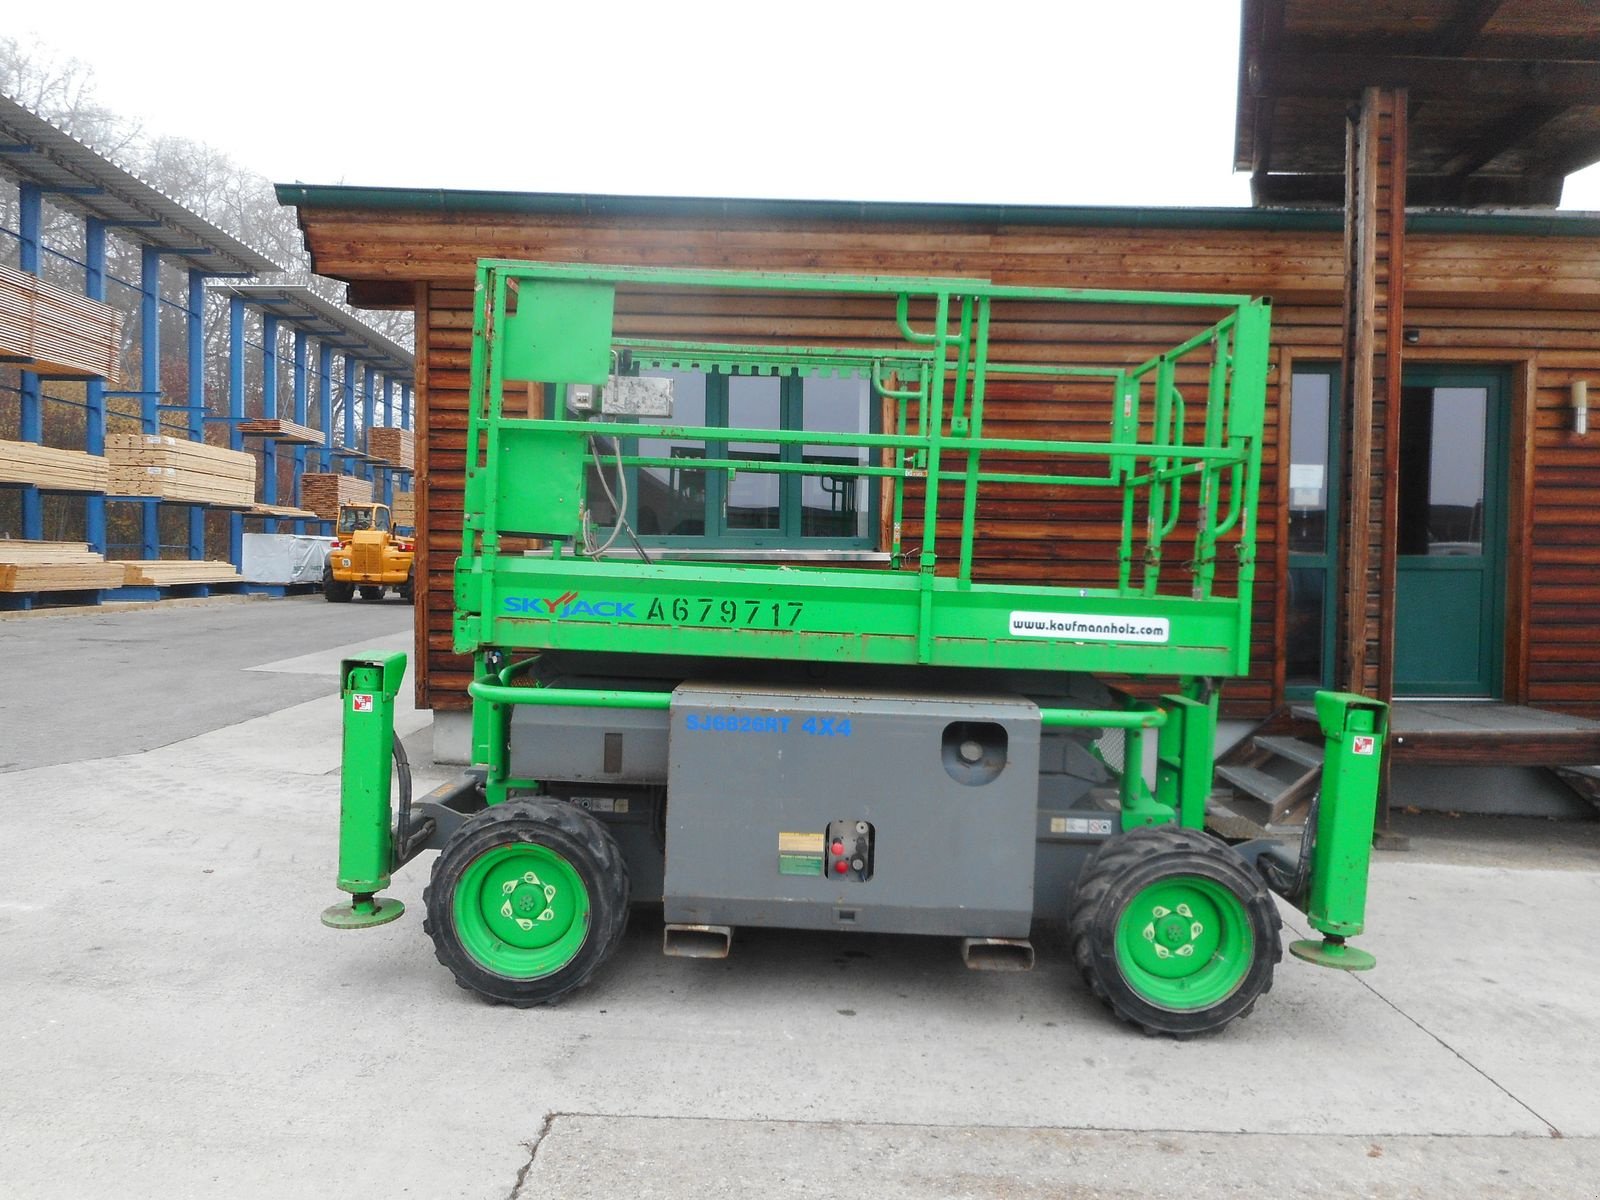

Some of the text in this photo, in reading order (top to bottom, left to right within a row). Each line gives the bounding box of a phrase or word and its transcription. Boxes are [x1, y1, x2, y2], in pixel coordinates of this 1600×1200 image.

[504, 591, 637, 618] SKYJACK
[647, 597, 803, 626] A679717
[1013, 619, 1164, 636] www.kaufmannholz.com
[686, 714, 852, 737] SJ6826RT 4X4
